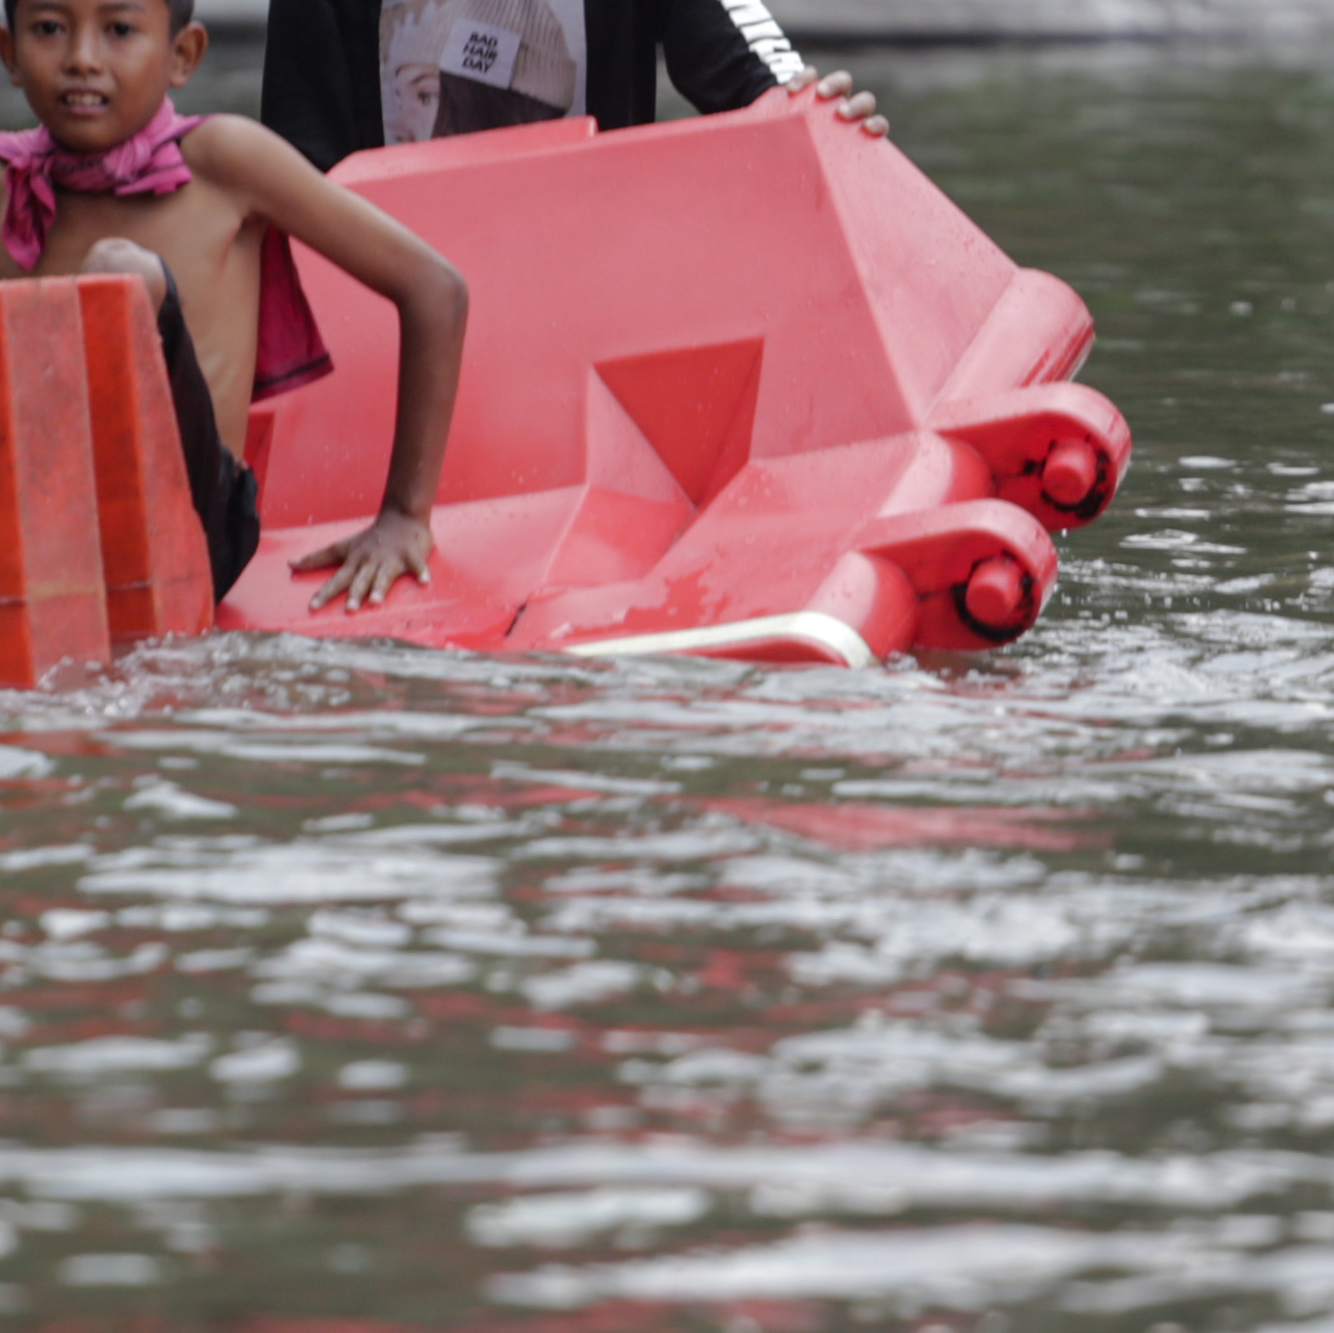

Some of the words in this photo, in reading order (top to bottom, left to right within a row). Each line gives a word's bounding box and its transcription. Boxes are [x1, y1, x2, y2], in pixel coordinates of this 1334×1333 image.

[469, 32, 498, 47] BAD
[462, 43, 498, 59] HAIR
[461, 56, 495, 74] DAY
